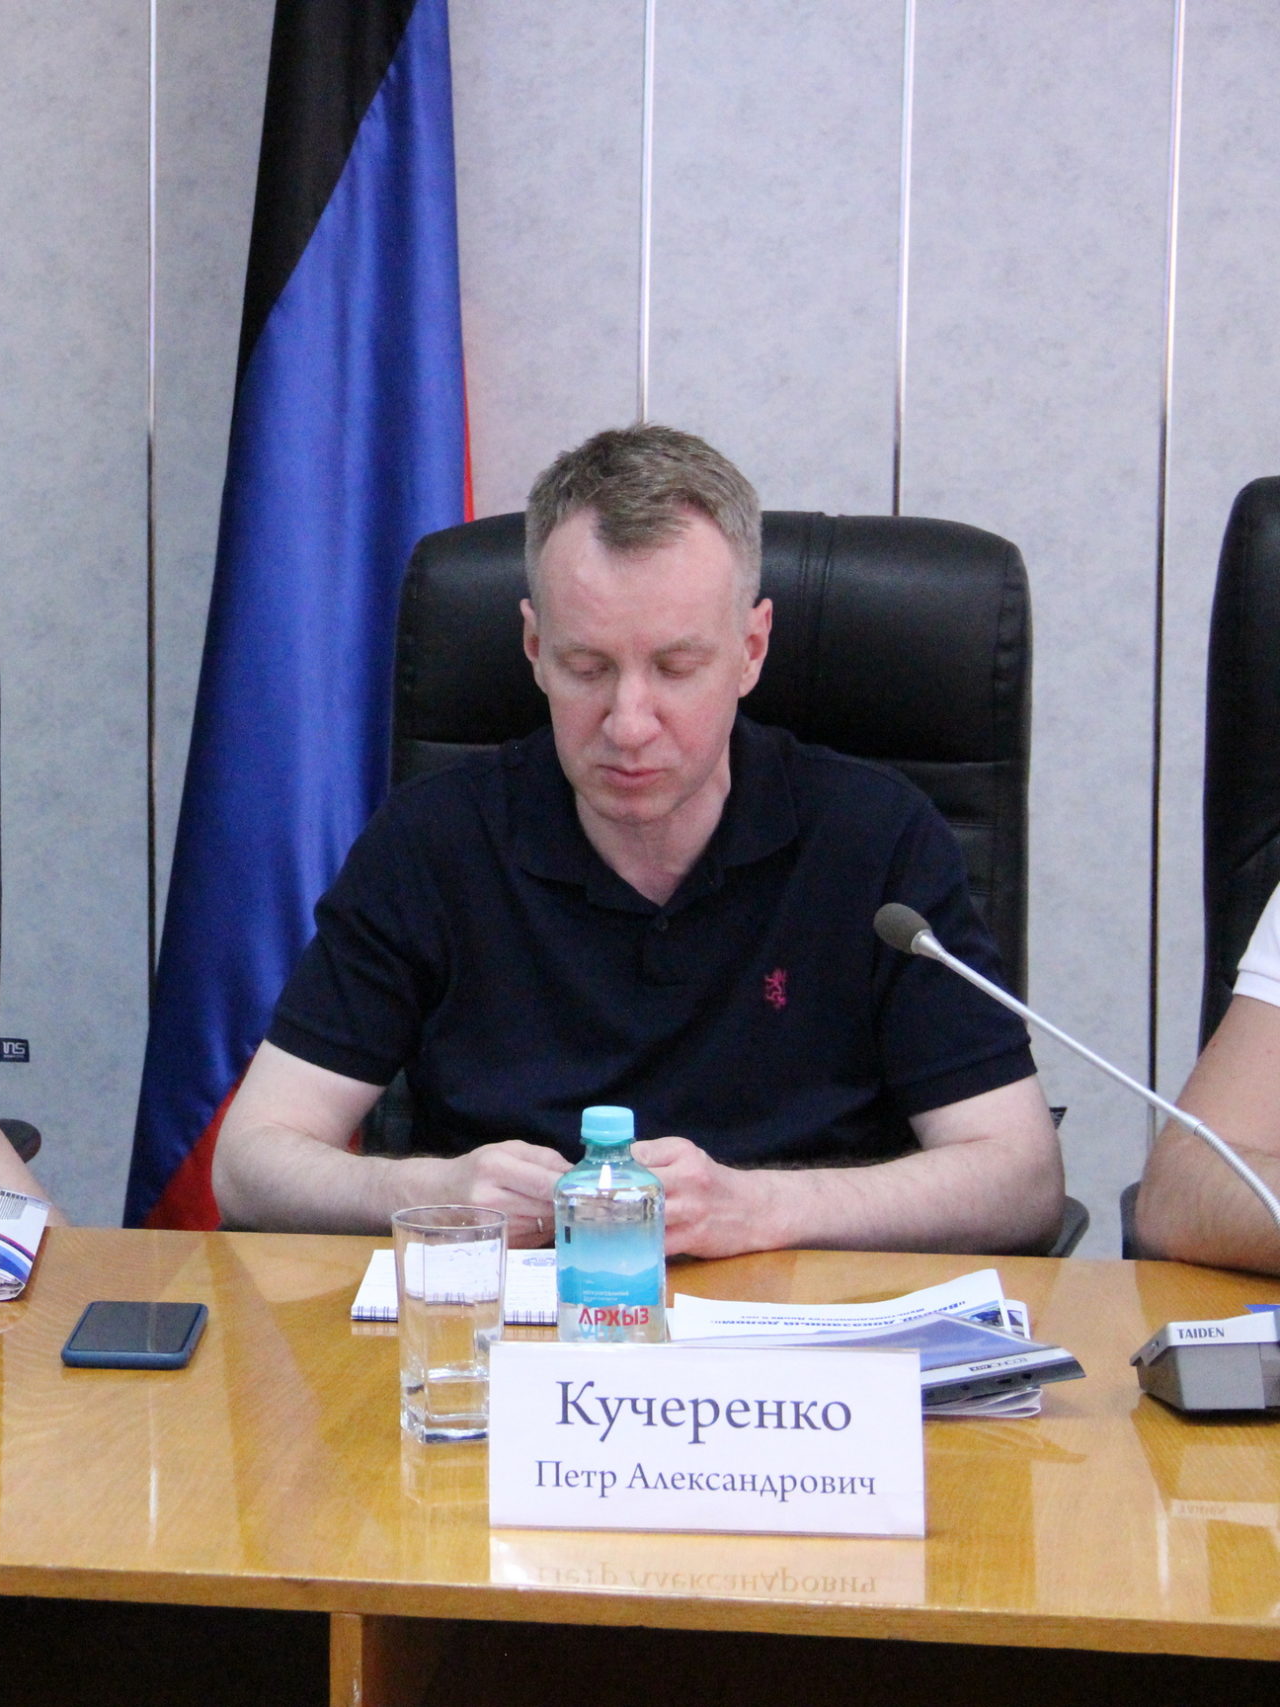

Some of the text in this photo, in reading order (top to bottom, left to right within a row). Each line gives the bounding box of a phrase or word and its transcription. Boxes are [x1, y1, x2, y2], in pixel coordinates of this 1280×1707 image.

[579, 1307, 650, 1327] АРХЫЗ
[1177, 1327, 1226, 1340] TAIDEN
[555, 1380, 852, 1445] Кучеренко
[535, 1460, 877, 1503] Петр Александрович
